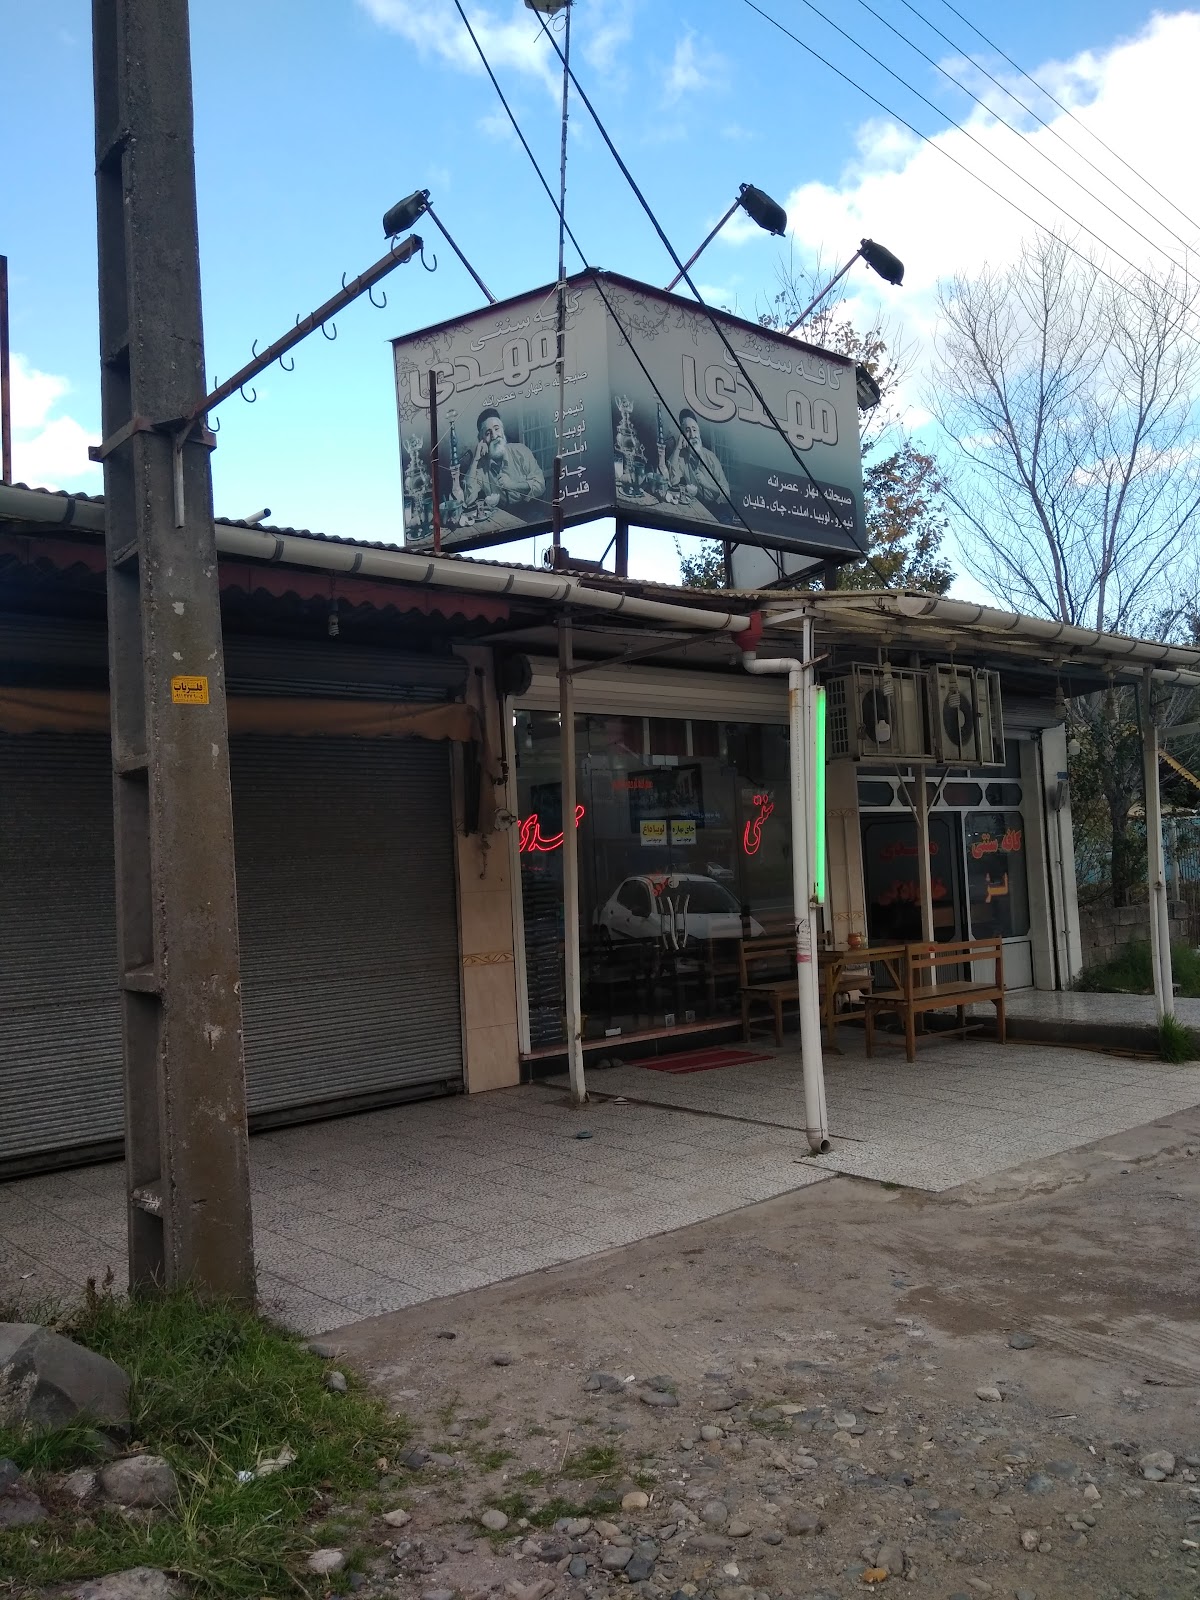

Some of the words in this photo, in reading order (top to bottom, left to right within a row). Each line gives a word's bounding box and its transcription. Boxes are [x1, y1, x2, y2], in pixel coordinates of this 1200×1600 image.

[532, 288, 583, 323] کاه
[469, 316, 531, 353] سنتی
[410, 327, 558, 410] مهدی
[723, 343, 793, 375] سنتی
[795, 360, 843, 391] کافه
[482, 391, 516, 407] عصرانه
[682, 353, 839, 452] مهدی
[554, 419, 587, 439] لوبیا
[767, 474, 799, 493] عصرانه
[742, 493, 766, 510] قلیان
[823, 487, 852, 507] صبحانه
[770, 499, 787, 517] چای
[791, 504, 809, 518] املت
[812, 507, 831, 526] لوبیا
[971, 833, 998, 859] سنتی
[1001, 828, 1021, 851] کافه
